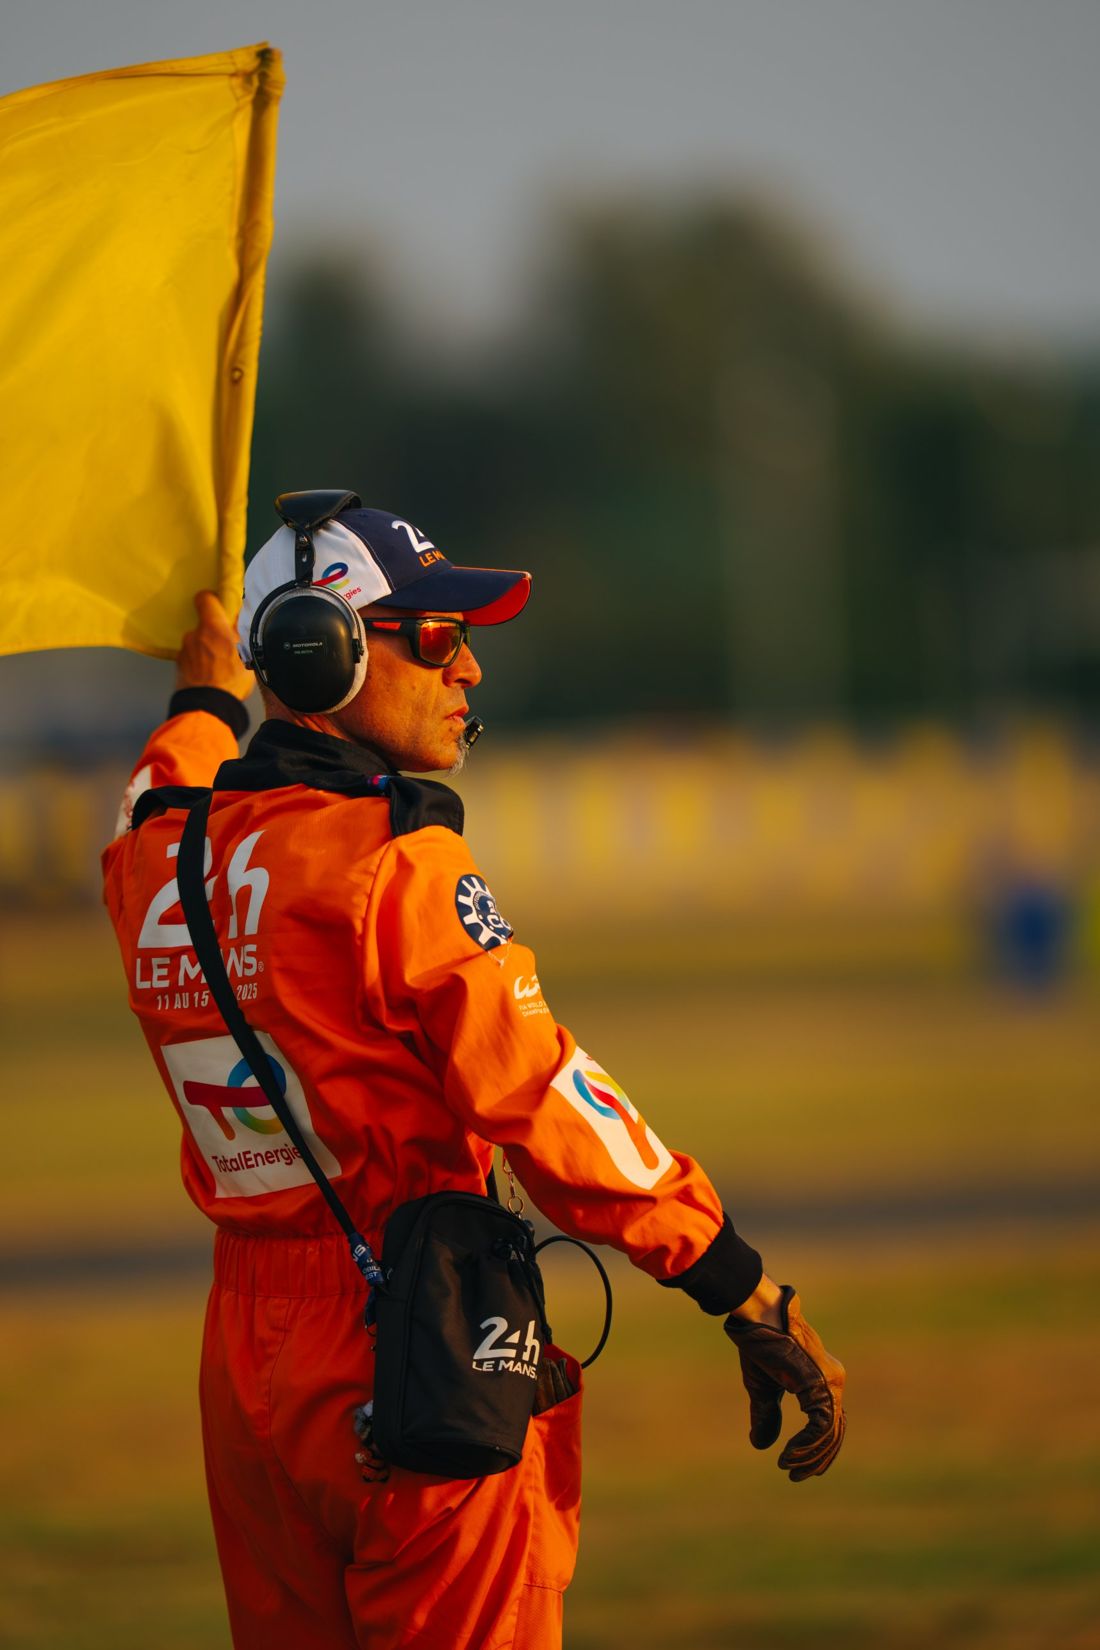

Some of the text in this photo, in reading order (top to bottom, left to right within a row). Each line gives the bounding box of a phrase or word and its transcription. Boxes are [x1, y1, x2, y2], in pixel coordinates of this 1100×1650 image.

[135, 944, 257, 989] LE MNS
[156, 983, 258, 1011] 11 AU 15 2025
[211, 1143, 303, 1173] TotalEnergie
[472, 1316, 541, 1366] 24h
[472, 1359, 537, 1379] LE MANS
